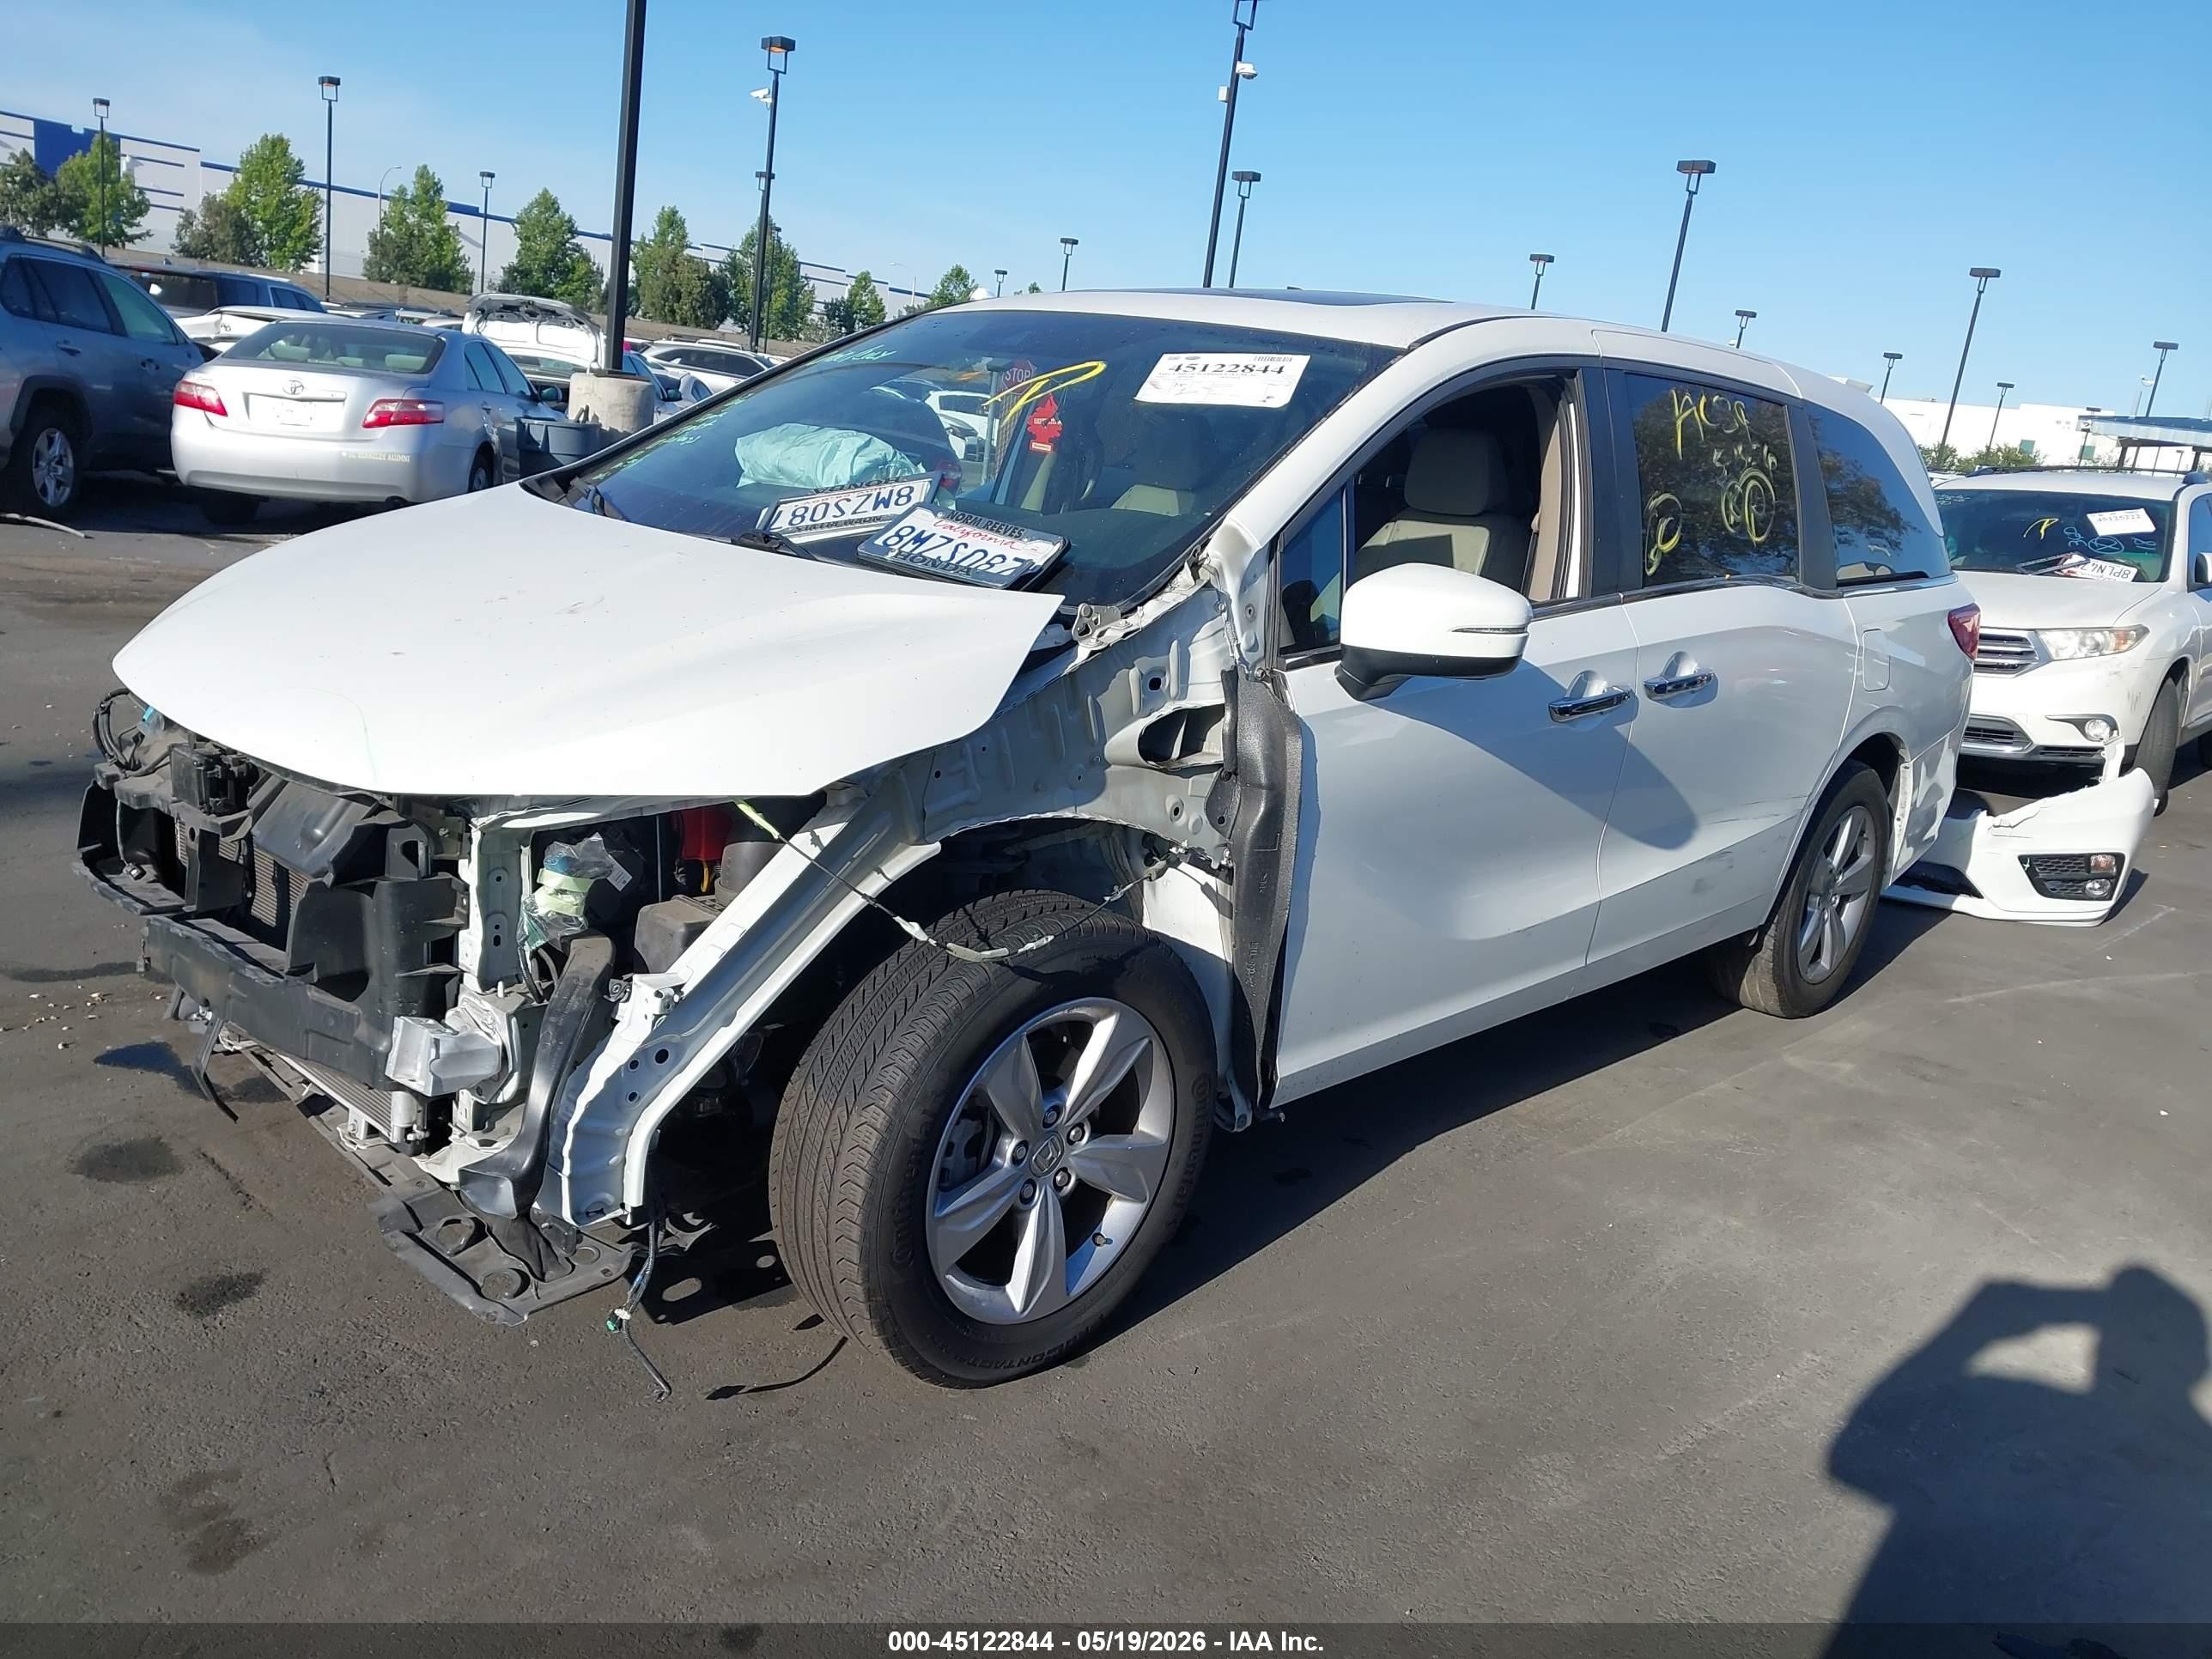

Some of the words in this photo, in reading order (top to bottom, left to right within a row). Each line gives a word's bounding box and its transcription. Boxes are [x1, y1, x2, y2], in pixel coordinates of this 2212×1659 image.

[1005, 368, 1030, 383] STOP
[1168, 362, 1285, 374] 45122844
[769, 485, 915, 531] 8MZS087
[933, 519, 1023, 551] California
[945, 510, 984, 529] NORM
[984, 520, 1025, 540] REEVES
[892, 550, 972, 577] HONDA
